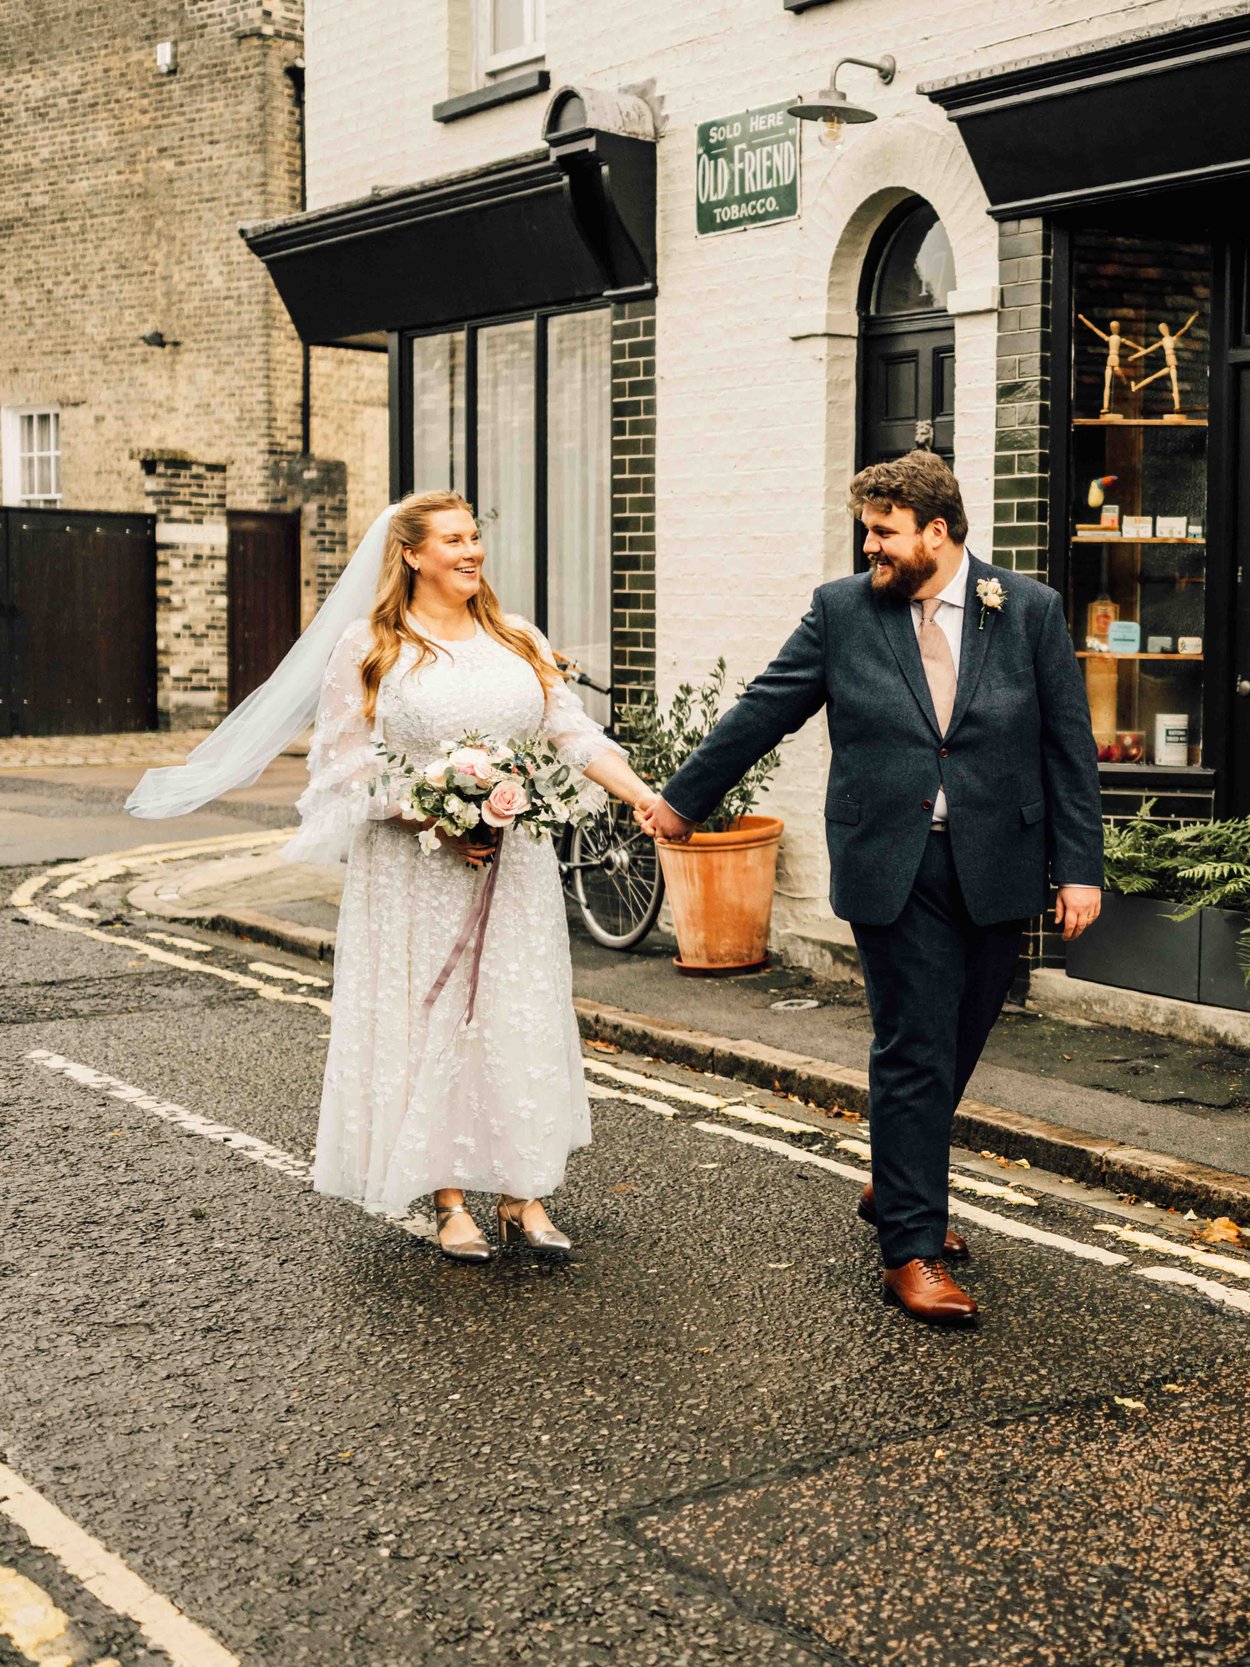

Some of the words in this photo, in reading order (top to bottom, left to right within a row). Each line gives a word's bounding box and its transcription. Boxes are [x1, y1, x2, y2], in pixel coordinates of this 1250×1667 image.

[709, 122, 741, 144] SOLD
[749, 111, 784, 133] HERE
[713, 196, 780, 223] TOBACCO.
